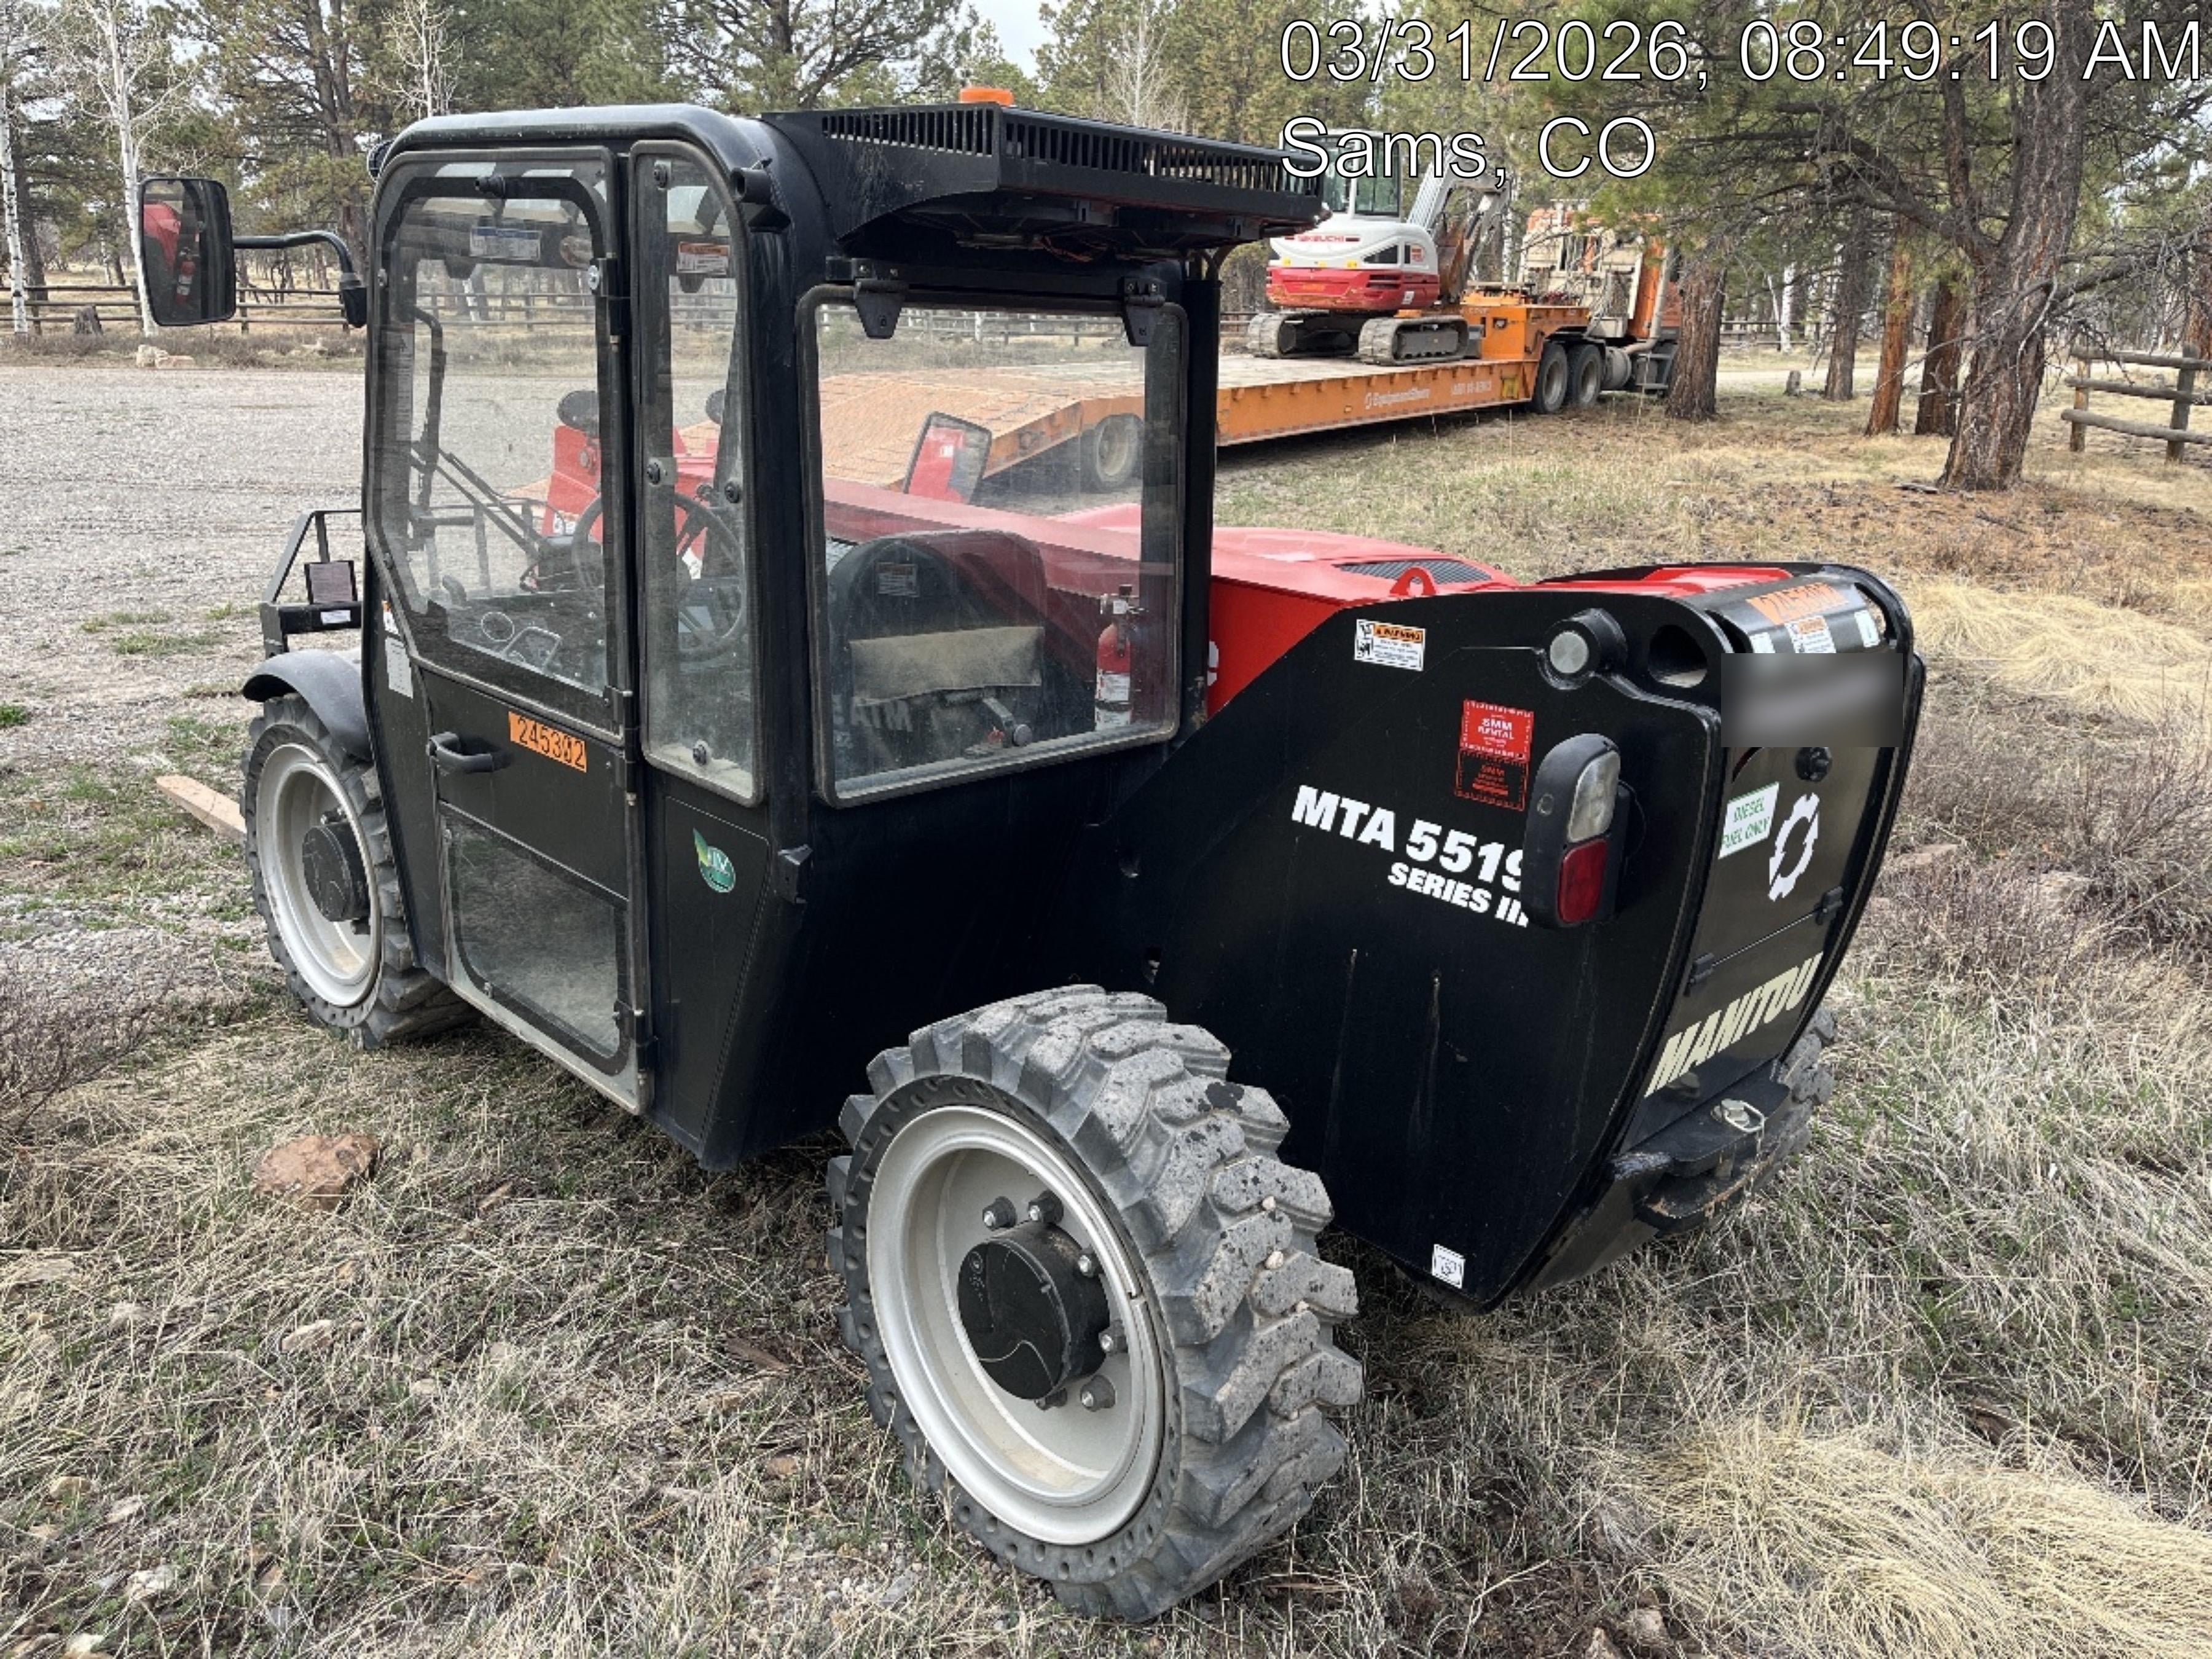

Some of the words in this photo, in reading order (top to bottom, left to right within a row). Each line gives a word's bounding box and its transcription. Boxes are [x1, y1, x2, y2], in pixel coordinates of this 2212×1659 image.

[518, 716, 585, 769] 245302
[1291, 785, 1395, 852] MTA
[1733, 797, 1765, 823] DIESEL
[1745, 816, 1770, 839] ONLY
[1387, 862, 1492, 914] SERIES
[1644, 951, 1824, 1098] MANITOU
